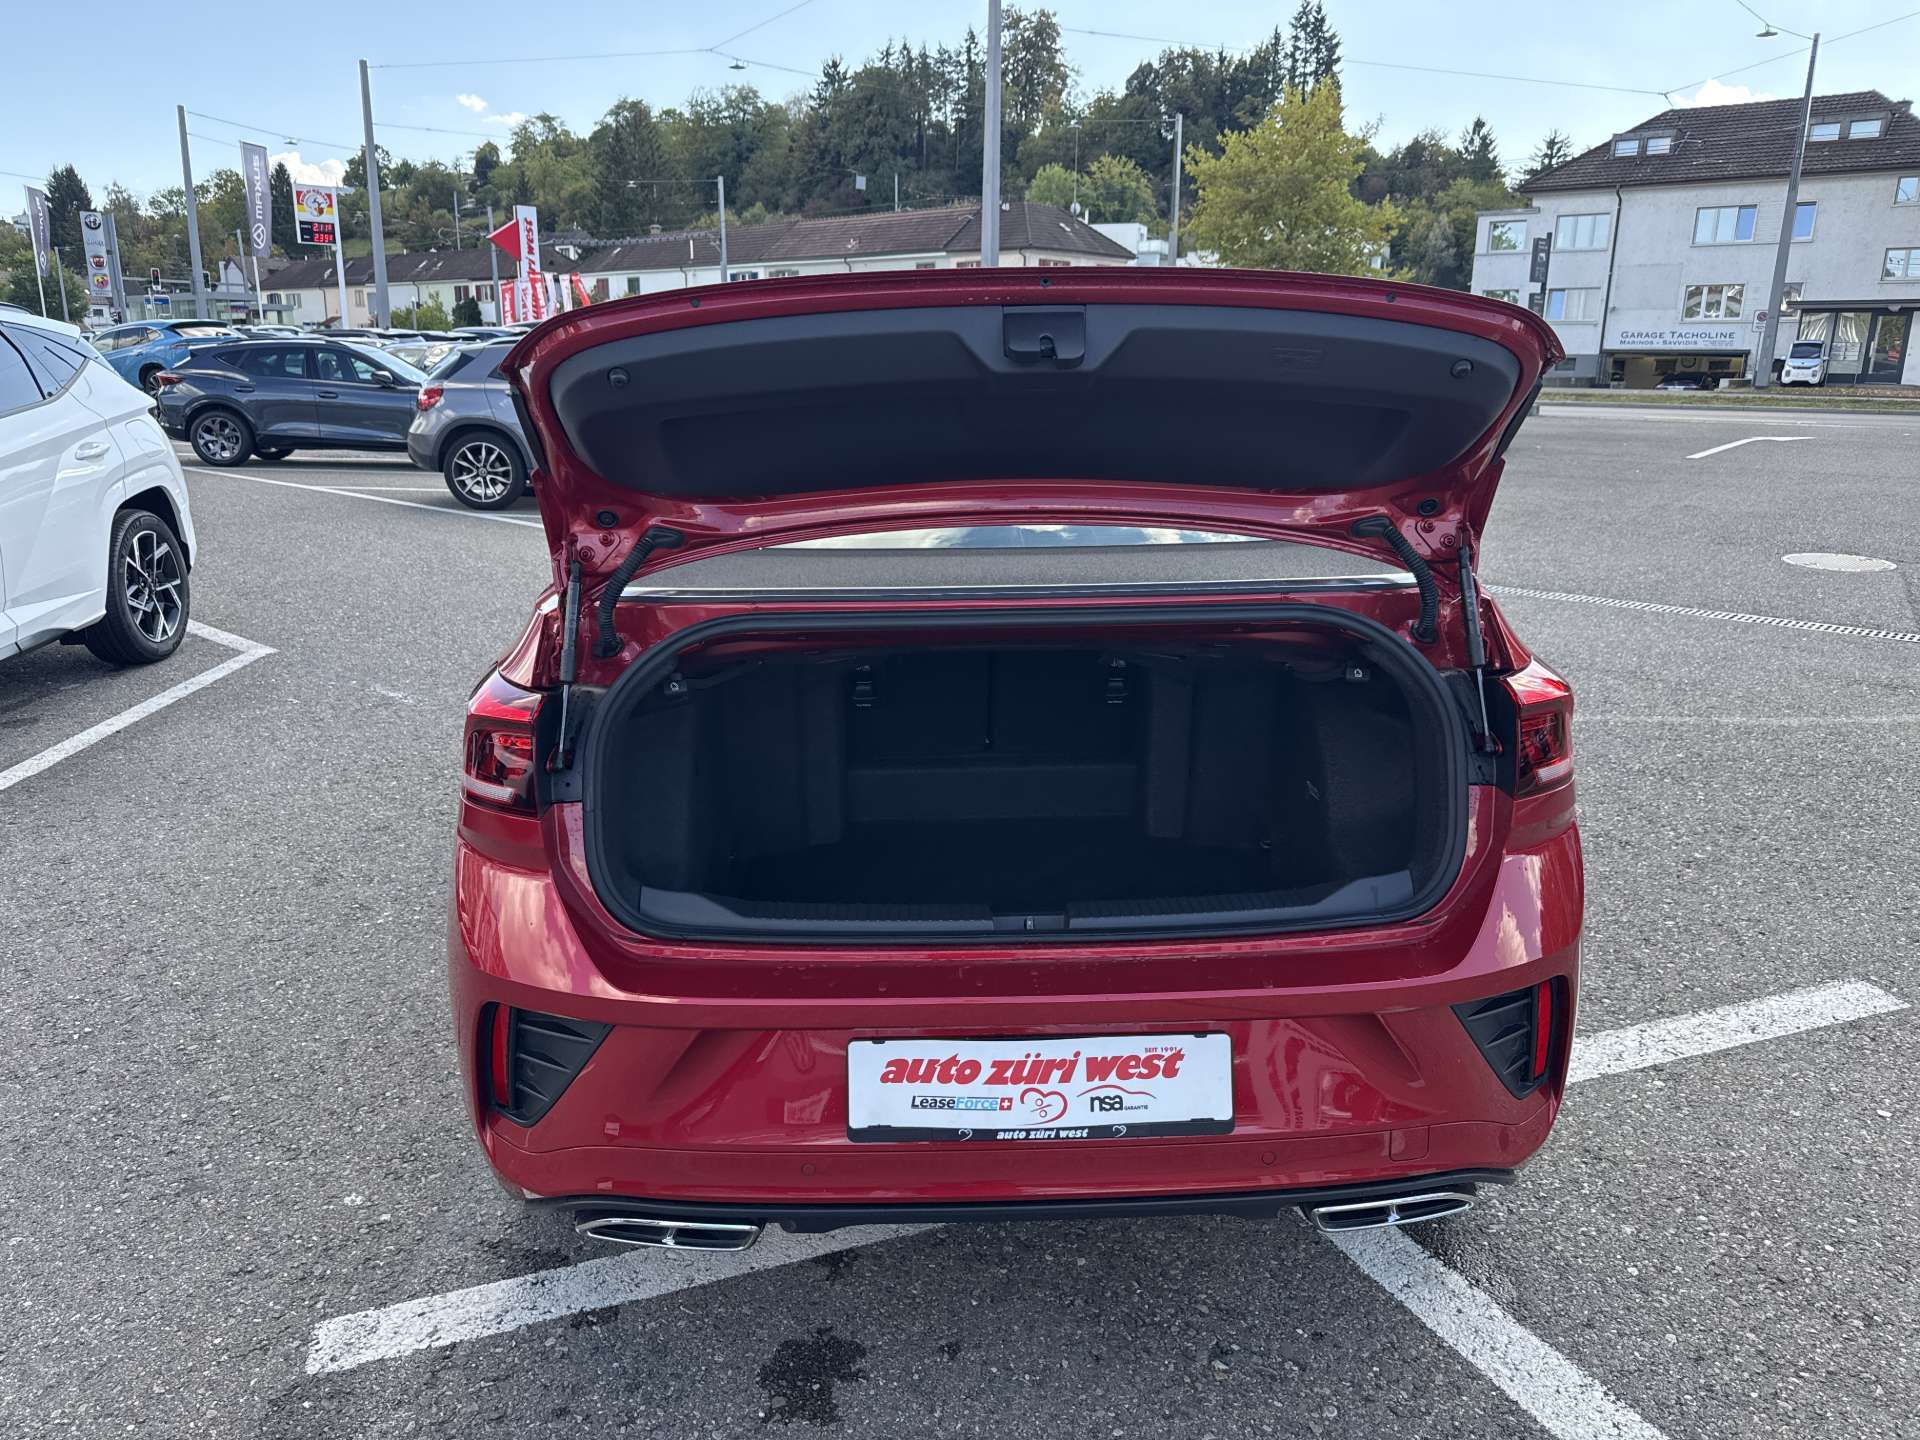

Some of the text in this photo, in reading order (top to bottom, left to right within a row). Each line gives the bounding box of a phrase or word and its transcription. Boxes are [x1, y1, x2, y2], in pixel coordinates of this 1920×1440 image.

[253, 154, 263, 220] MAXUS
[1620, 331, 1736, 339] GARAGE TACHOLINE
[879, 1048, 1185, 1085] auto züri west
[911, 1095, 998, 1109] LeaseForce
[1090, 1095, 1124, 1112] nsa
[996, 1128, 1089, 1139] auto züri west
